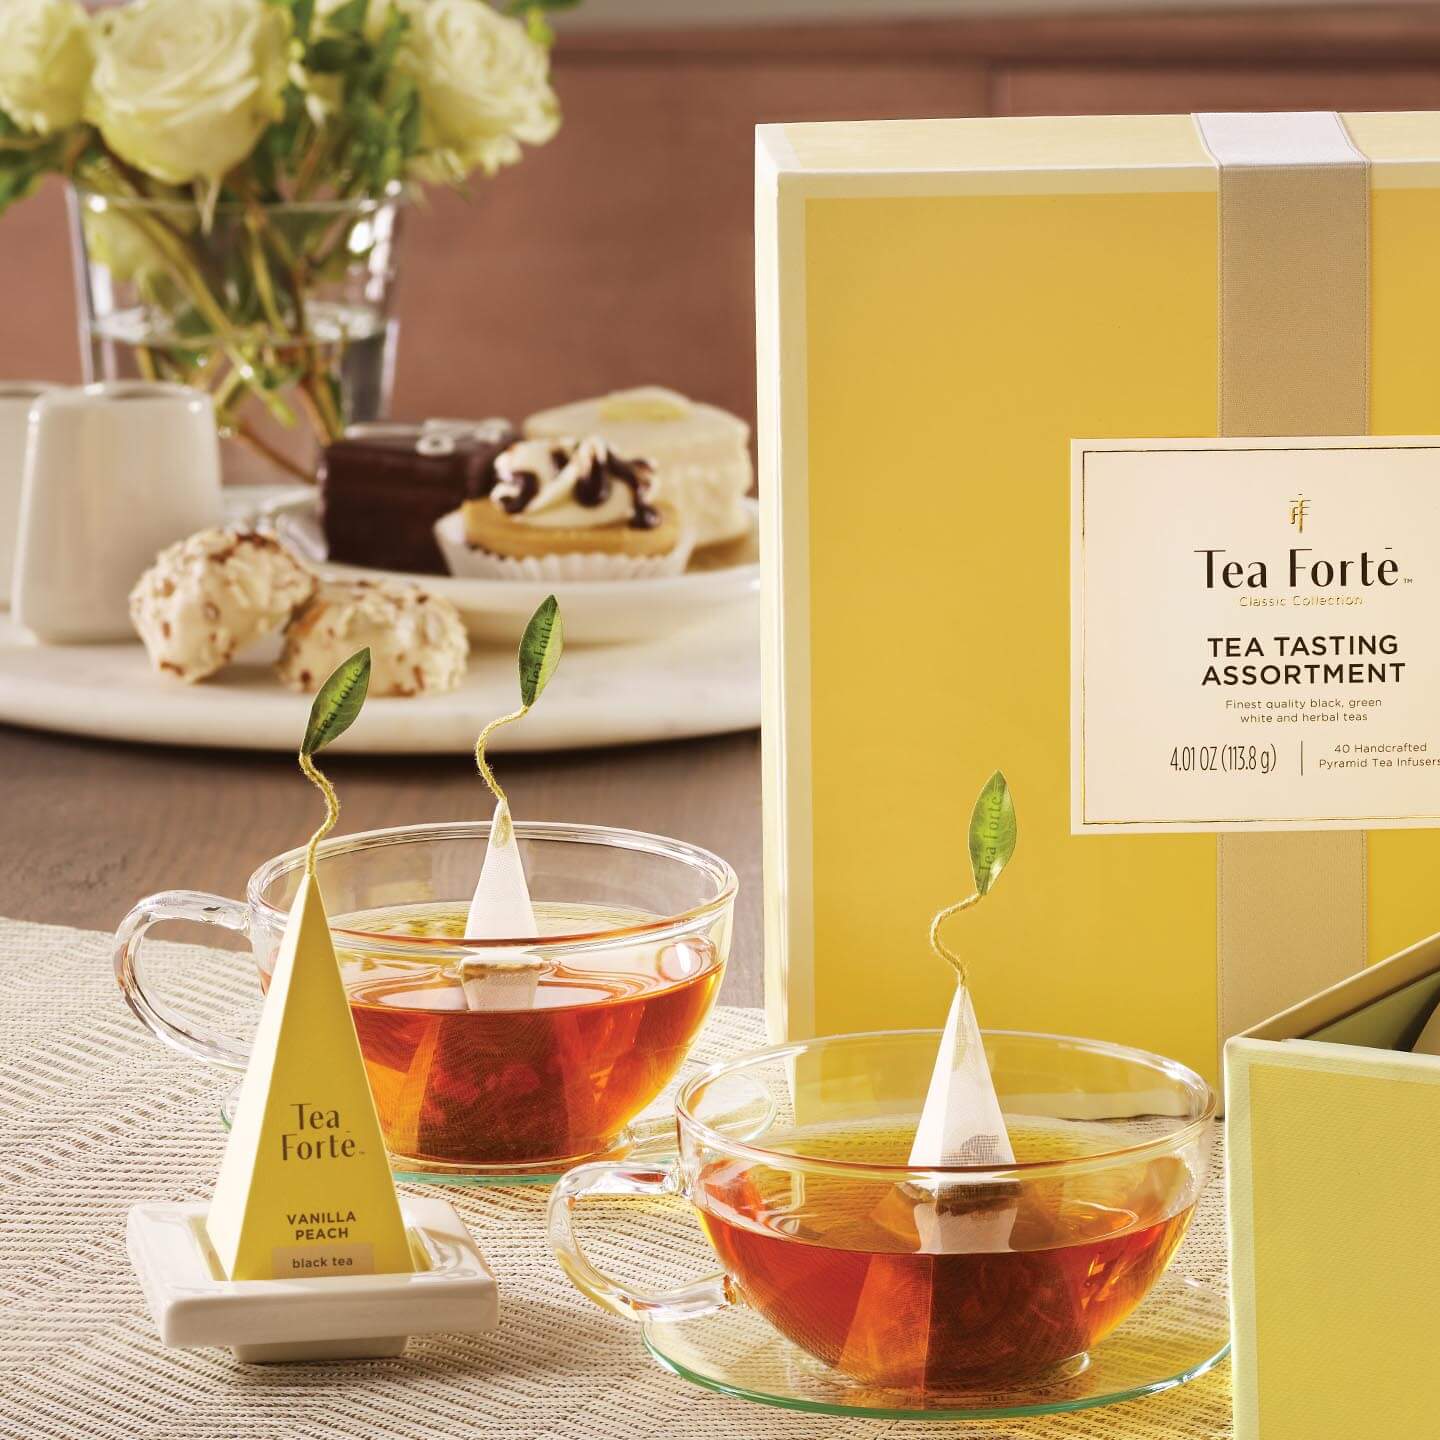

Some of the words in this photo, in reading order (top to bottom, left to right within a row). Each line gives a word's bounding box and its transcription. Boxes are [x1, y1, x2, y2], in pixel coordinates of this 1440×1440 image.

[1193, 550, 1267, 588] Tea
[1239, 596, 1285, 607] Classic
[1293, 595, 1362, 606] Collection
[1207, 638, 1264, 657] TEA
[1274, 635, 1398, 656] TASTING
[1201, 663, 1406, 686] ASSORTMENT
[1226, 700, 1261, 709] Finest
[1266, 699, 1306, 711] quality
[1310, 698, 1344, 709] black,
[1348, 699, 1382, 710] green
[1240, 714, 1272, 723] white
[1278, 714, 1298, 722] and
[1302, 712, 1339, 722] herbal
[1343, 713, 1368, 722] teas
[1334, 744, 1350, 753] 40
[1354, 743, 1427, 753] Handcrafted
[1170, 746, 1195, 771] 4.01
[1200, 746, 1217, 770] OZ
[1221, 744, 1257, 771] (113.8
[1261, 744, 1276, 774] g)
[1319, 759, 1367, 770] Pyramid
[1372, 758, 1392, 767] Tea
[290, 1103, 340, 1130] Tea
[287, 1211, 357, 1225] VANILLA
[295, 1227, 349, 1240] PEACH
[293, 1258, 328, 1269] black
[333, 1257, 353, 1266] tea
